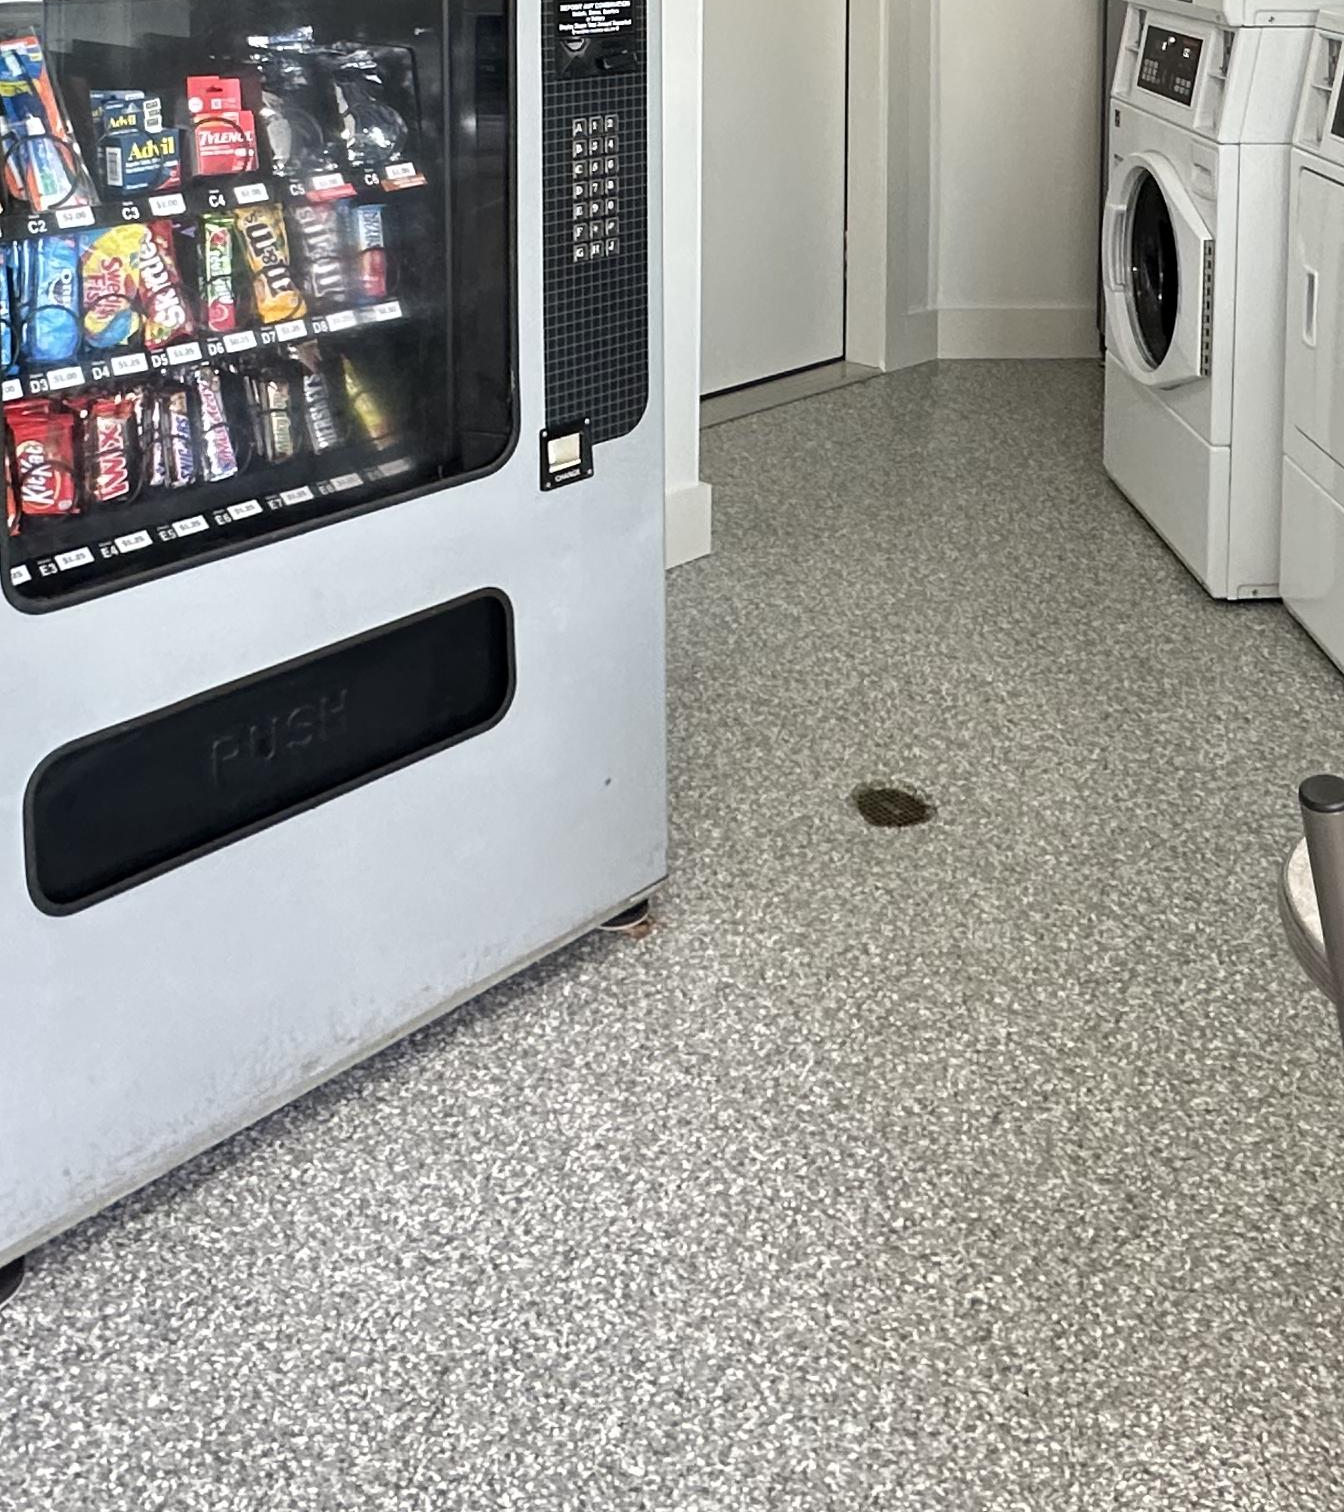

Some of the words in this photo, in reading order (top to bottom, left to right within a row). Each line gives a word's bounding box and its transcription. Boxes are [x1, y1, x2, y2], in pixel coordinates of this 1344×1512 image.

[128, 136, 175, 161] Advil
[28, 219, 47, 234] C2
[86, 274, 105, 307] Fis
[208, 342, 224, 356] D6
[151, 354, 168, 368] D5
[92, 366, 110, 380] D4
[30, 378, 48, 393] D3
[209, 689, 348, 787] PUSH
